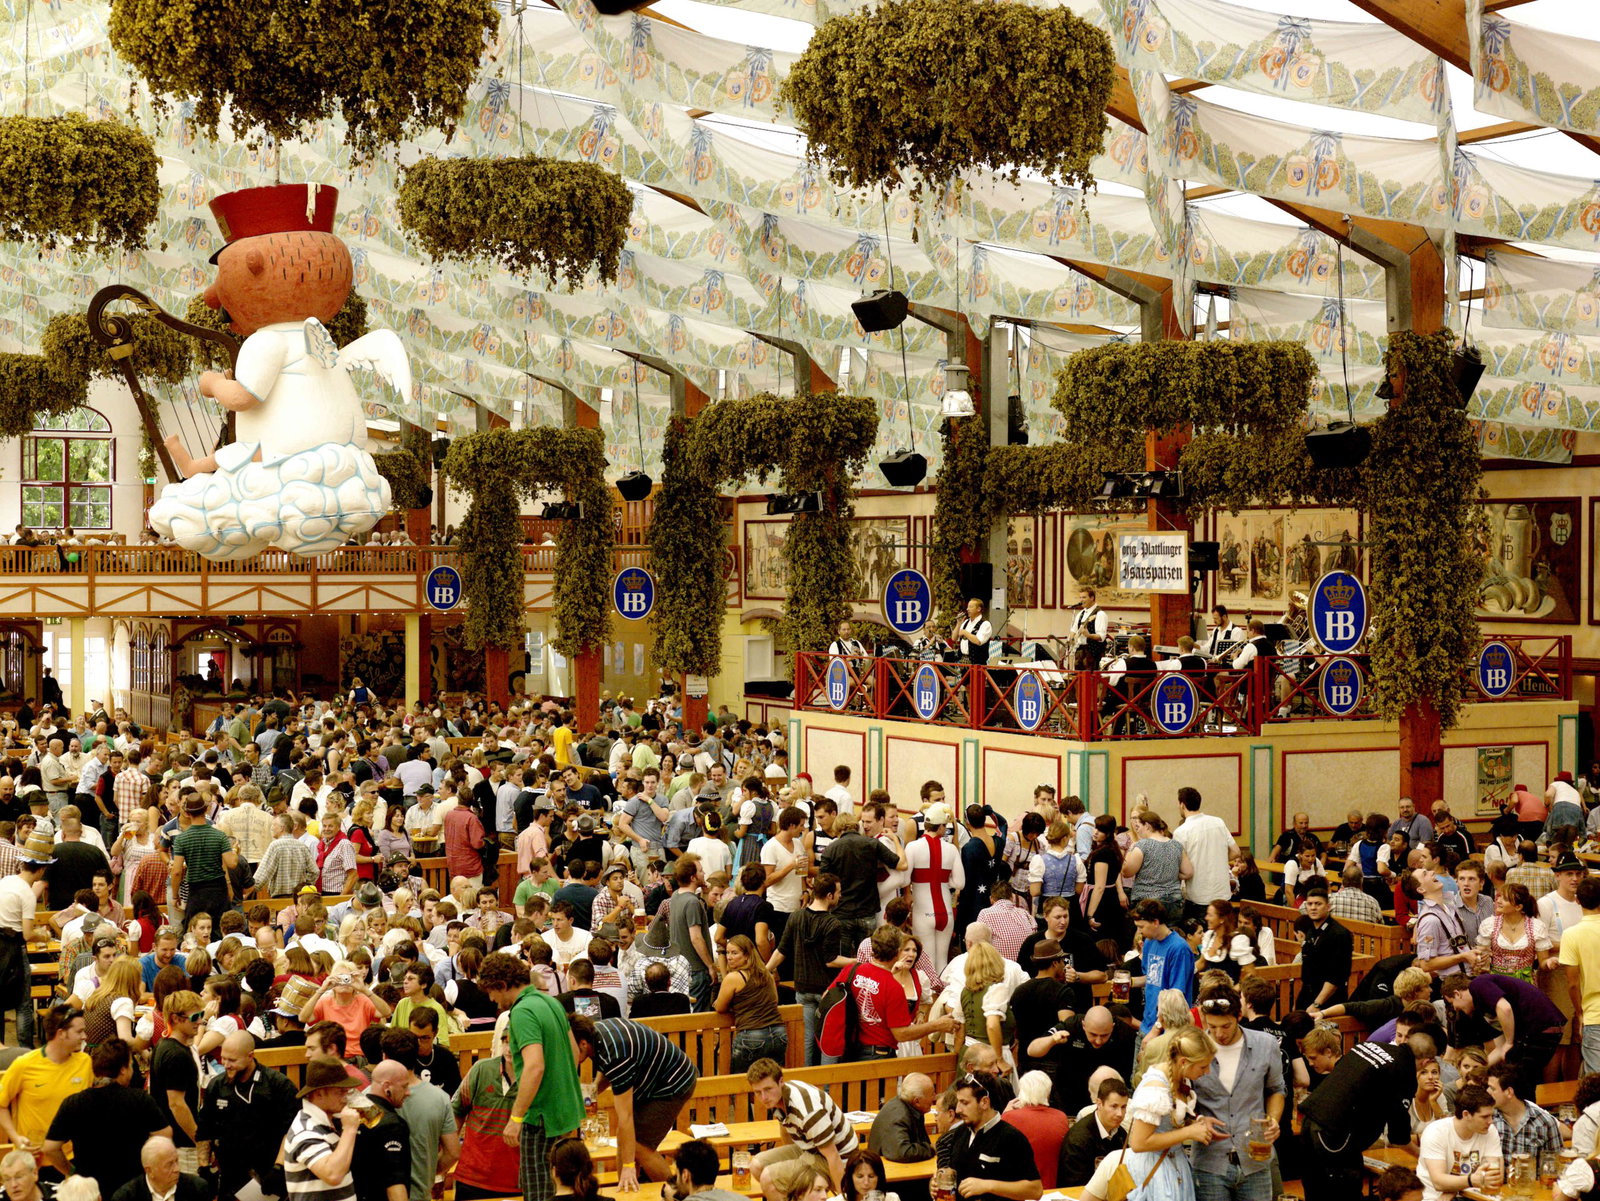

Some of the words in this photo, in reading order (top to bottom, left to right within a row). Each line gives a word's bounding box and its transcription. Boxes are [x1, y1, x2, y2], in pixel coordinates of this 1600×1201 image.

[1121, 543, 1138, 558] orig.
[1142, 541, 1182, 558] Plattlinger
[1122, 562, 1183, 582] Isarspatzen
[434, 587, 454, 604] HB
[623, 593, 646, 613] HB
[895, 600, 922, 624] HB
[1325, 611, 1356, 641] HB
[1486, 669, 1507, 689] HB
[832, 683, 843, 701] HB
[920, 691, 933, 711] HB
[1331, 685, 1352, 706] HB
[1022, 700, 1037, 720] HB
[1164, 703, 1186, 723] HB
